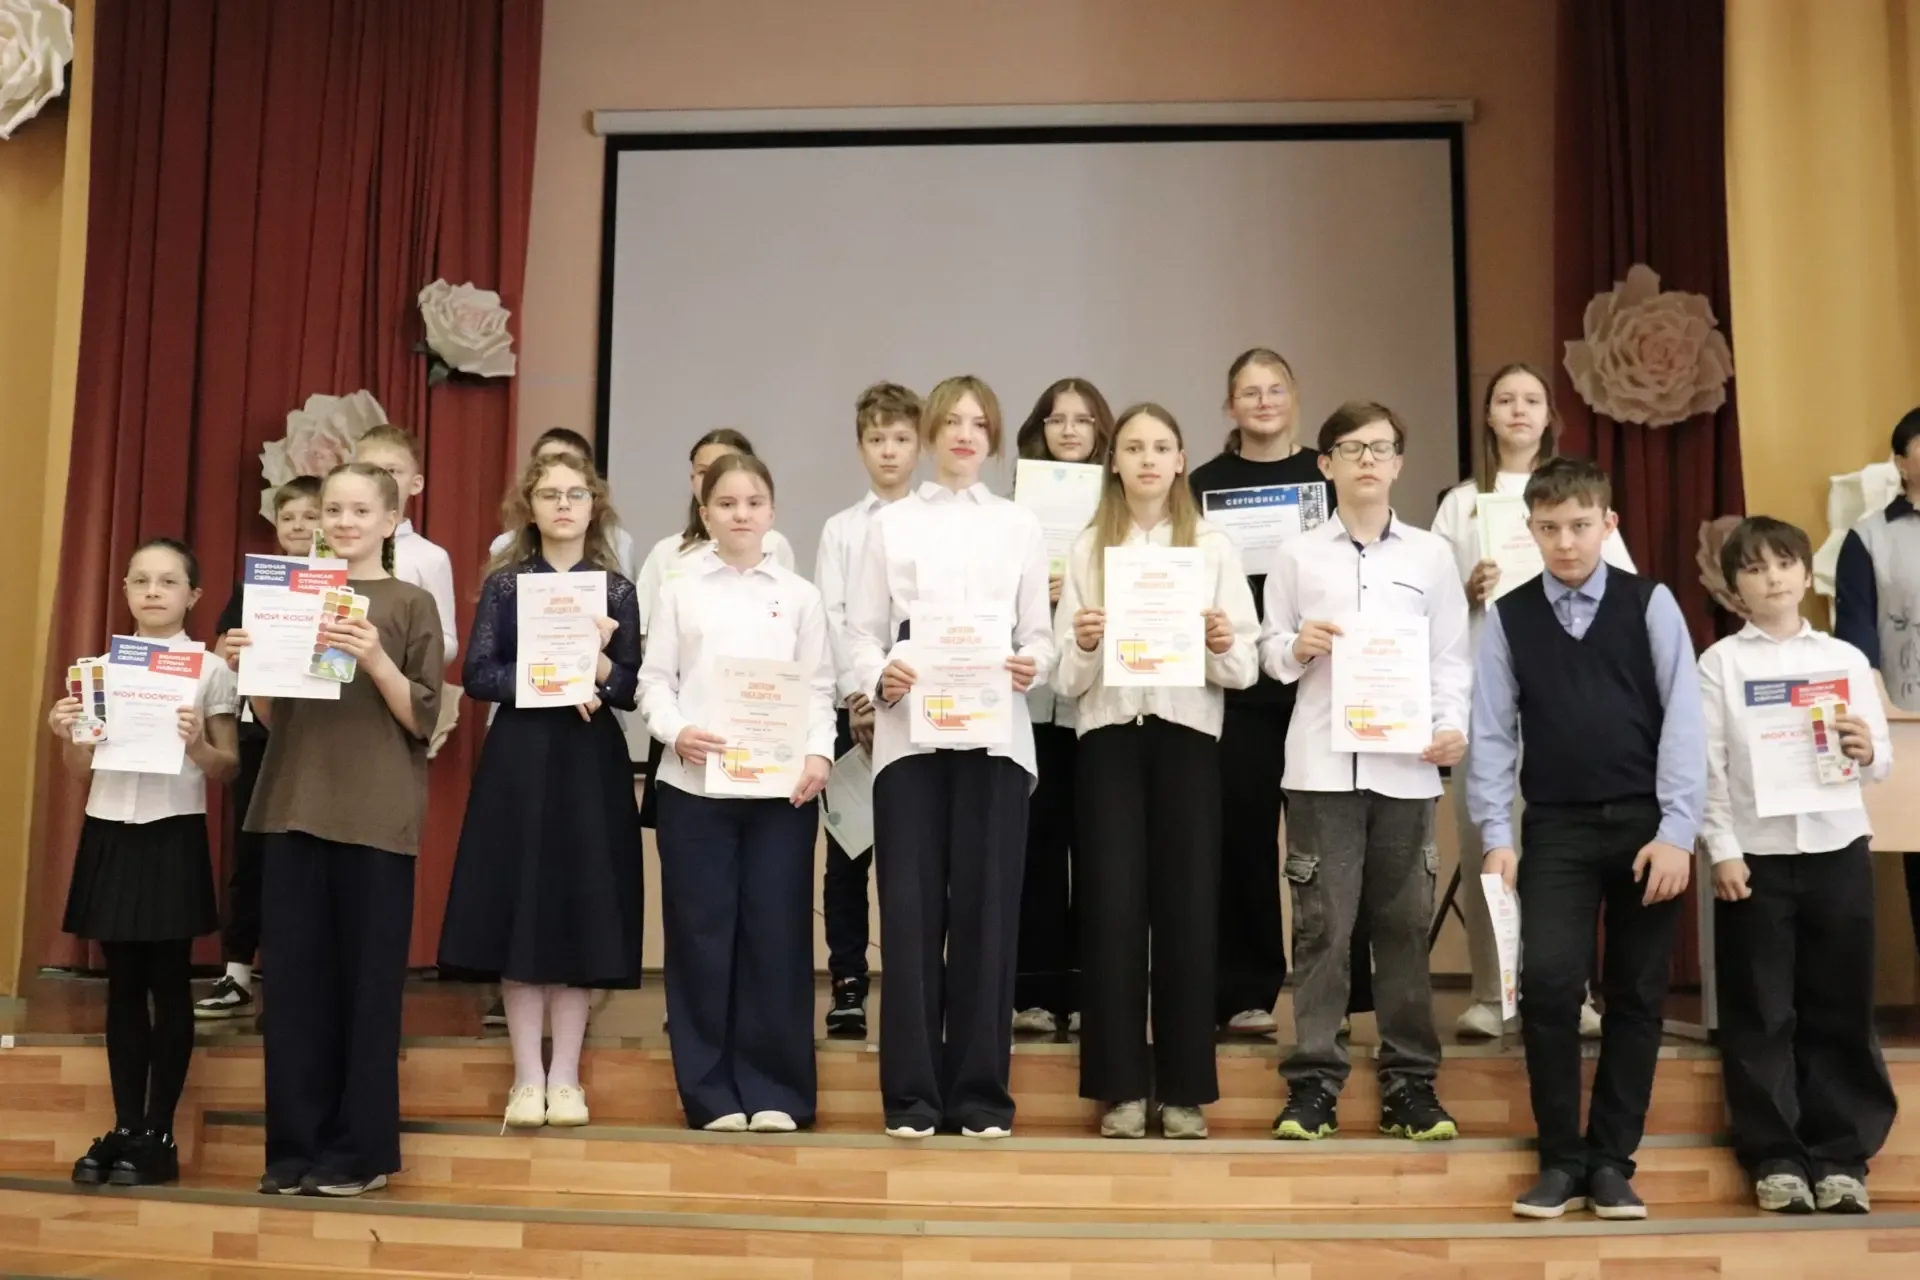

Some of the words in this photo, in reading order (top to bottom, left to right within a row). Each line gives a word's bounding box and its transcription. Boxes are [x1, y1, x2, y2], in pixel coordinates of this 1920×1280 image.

[1225, 494, 1287, 506] СЕРТИФИКАТ
[254, 612, 280, 621] МОЙ
[112, 690, 136, 699] МОЙ
